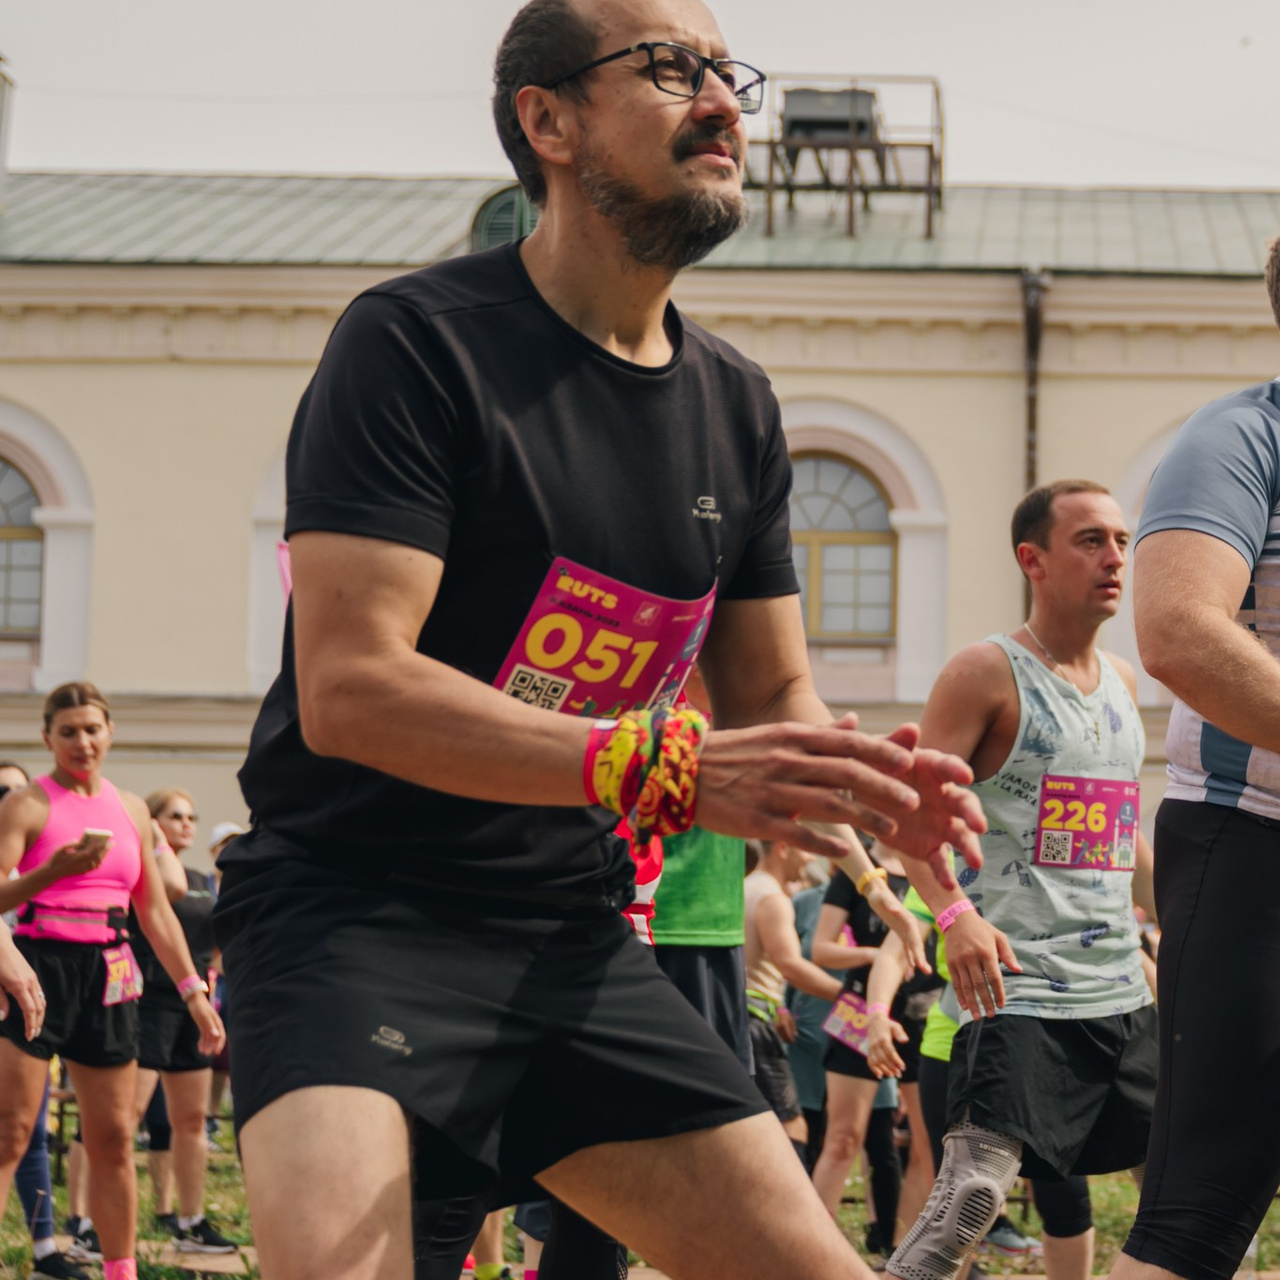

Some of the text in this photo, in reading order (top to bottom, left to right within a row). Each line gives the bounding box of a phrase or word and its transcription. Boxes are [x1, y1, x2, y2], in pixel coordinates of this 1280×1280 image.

[556, 575, 619, 609] RUTS
[525, 613, 658, 688] 051
[1046, 780, 1075, 791] RUTS
[1041, 799, 1106, 833] 226
